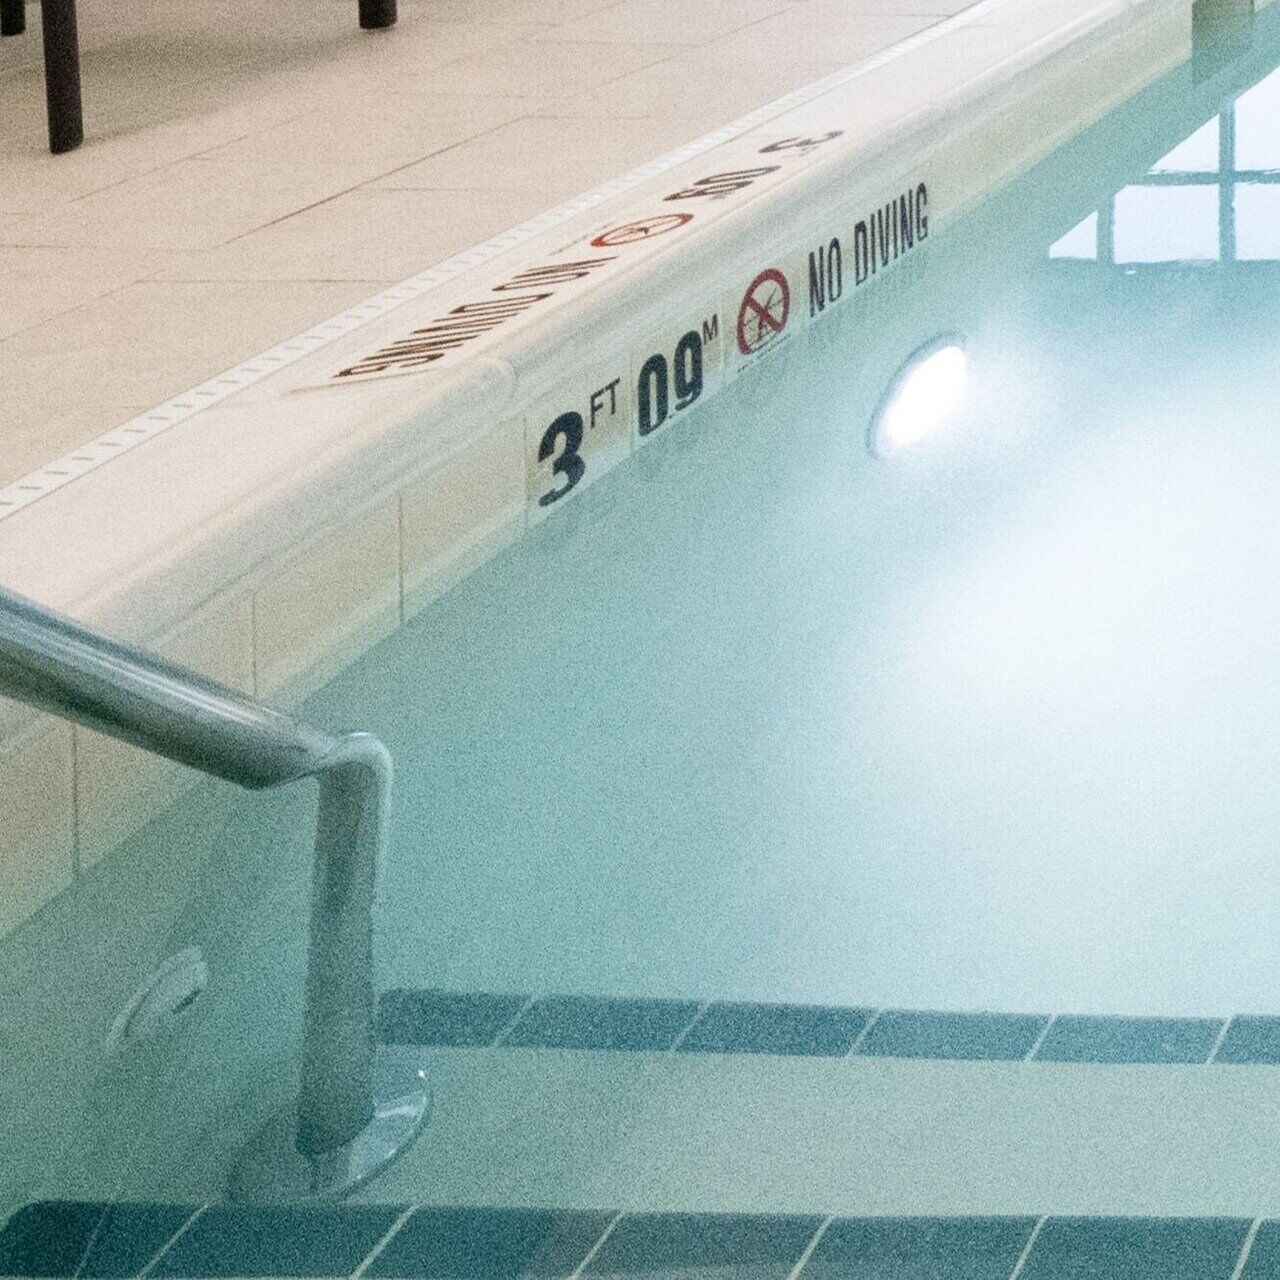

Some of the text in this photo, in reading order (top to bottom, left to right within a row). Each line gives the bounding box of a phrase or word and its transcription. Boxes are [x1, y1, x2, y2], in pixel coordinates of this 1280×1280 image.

[538, 411, 586, 507] 3
[590, 377, 620, 429] FT
[702, 313, 719, 345] M
[808, 237, 842, 318] NO
[853, 182, 929, 286] DIVING
